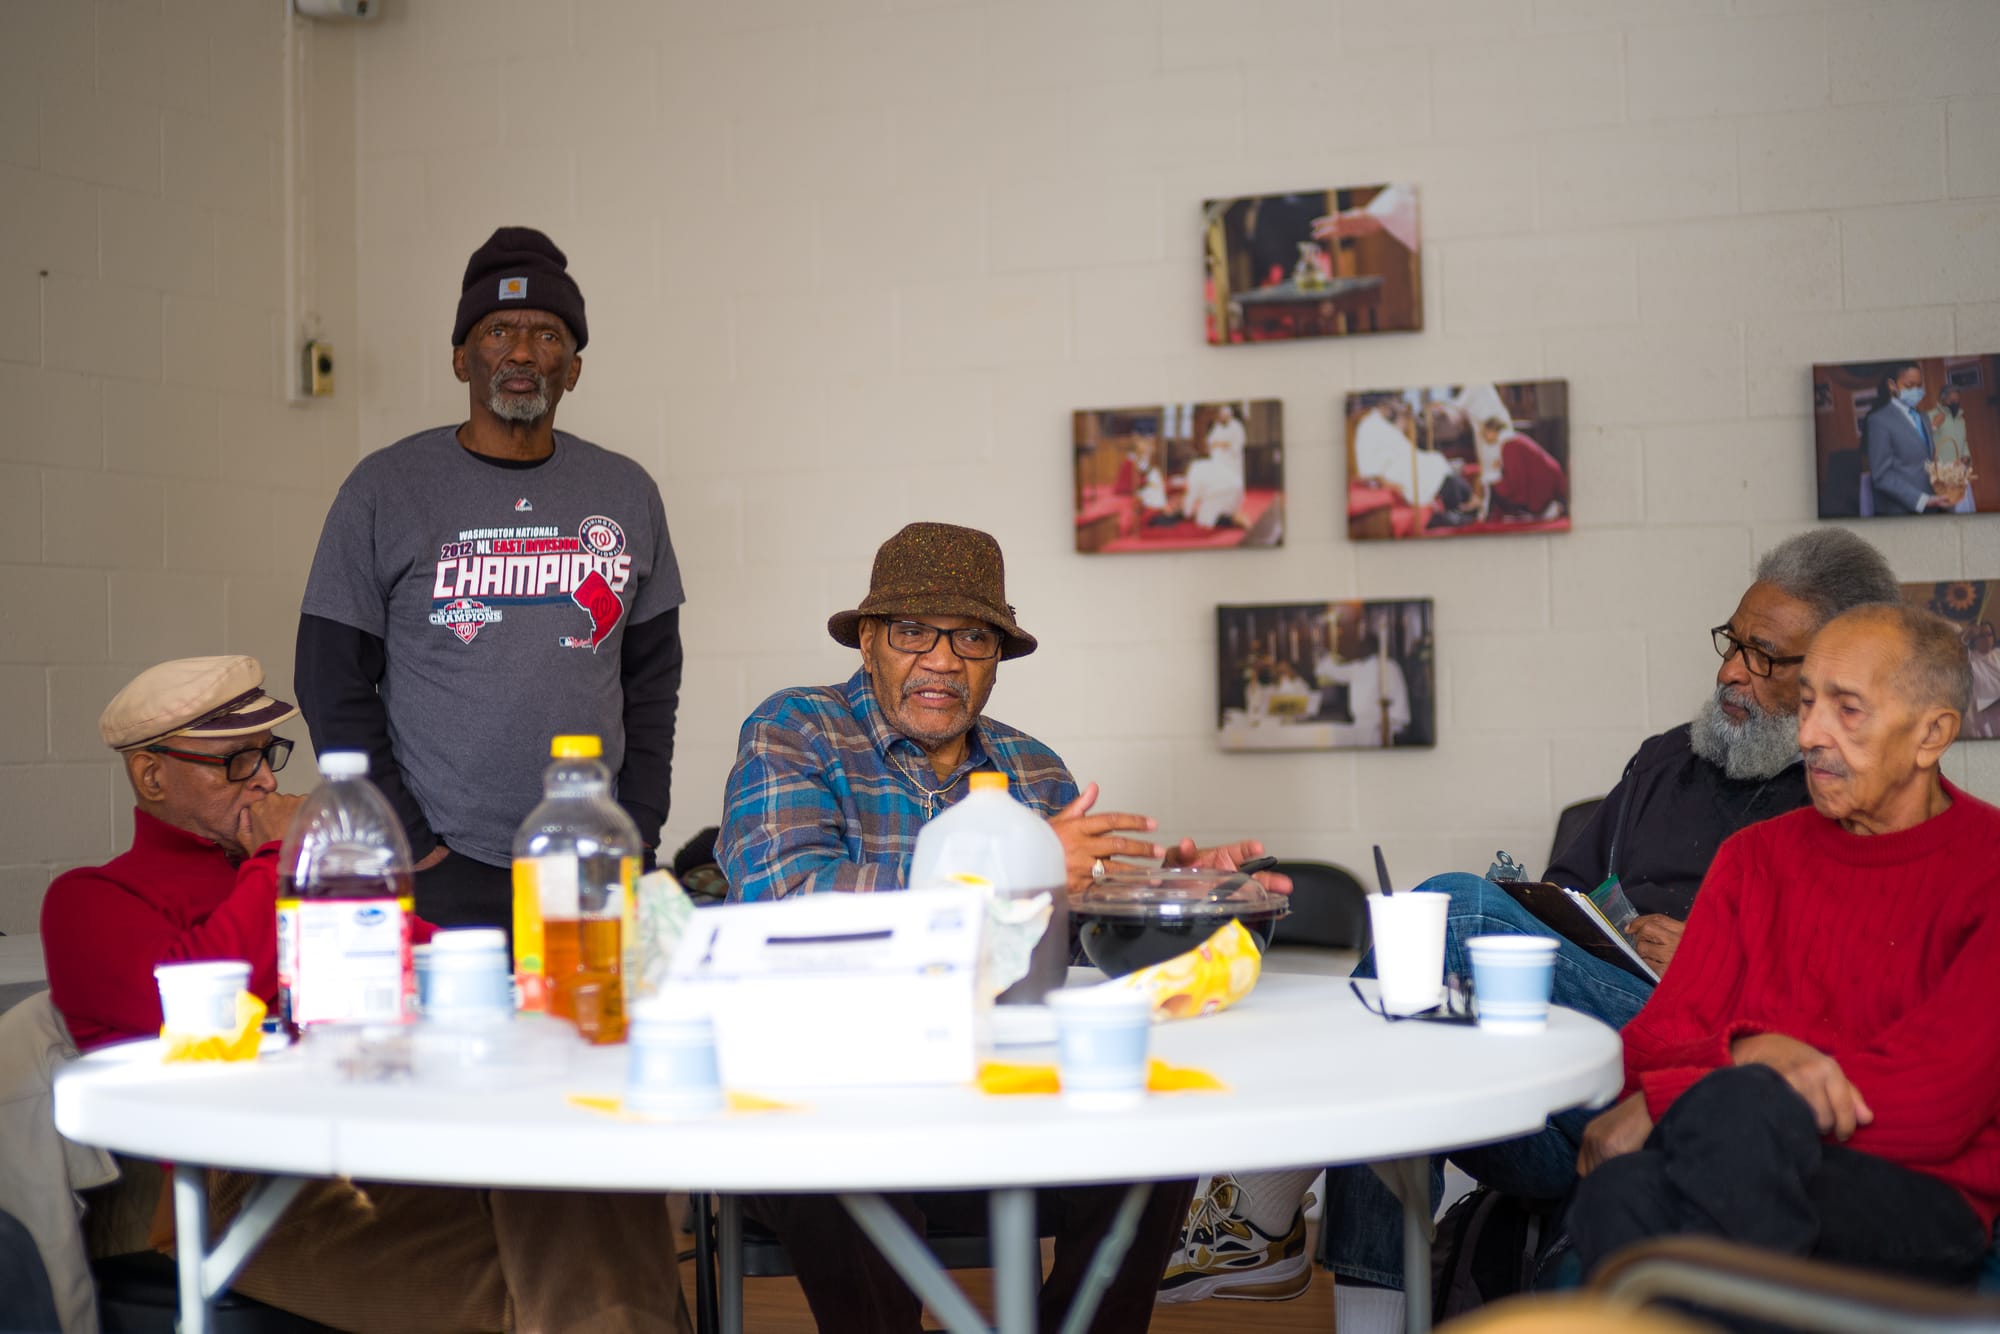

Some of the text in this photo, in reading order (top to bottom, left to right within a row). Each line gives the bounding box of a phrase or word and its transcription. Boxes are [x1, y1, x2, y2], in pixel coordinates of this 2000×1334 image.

[459, 526, 559, 541] WASHINGTON NATIONALS
[441, 537, 579, 560] 2012 NL EAST DIVISION
[430, 610, 502, 625] CHAMPIONS
